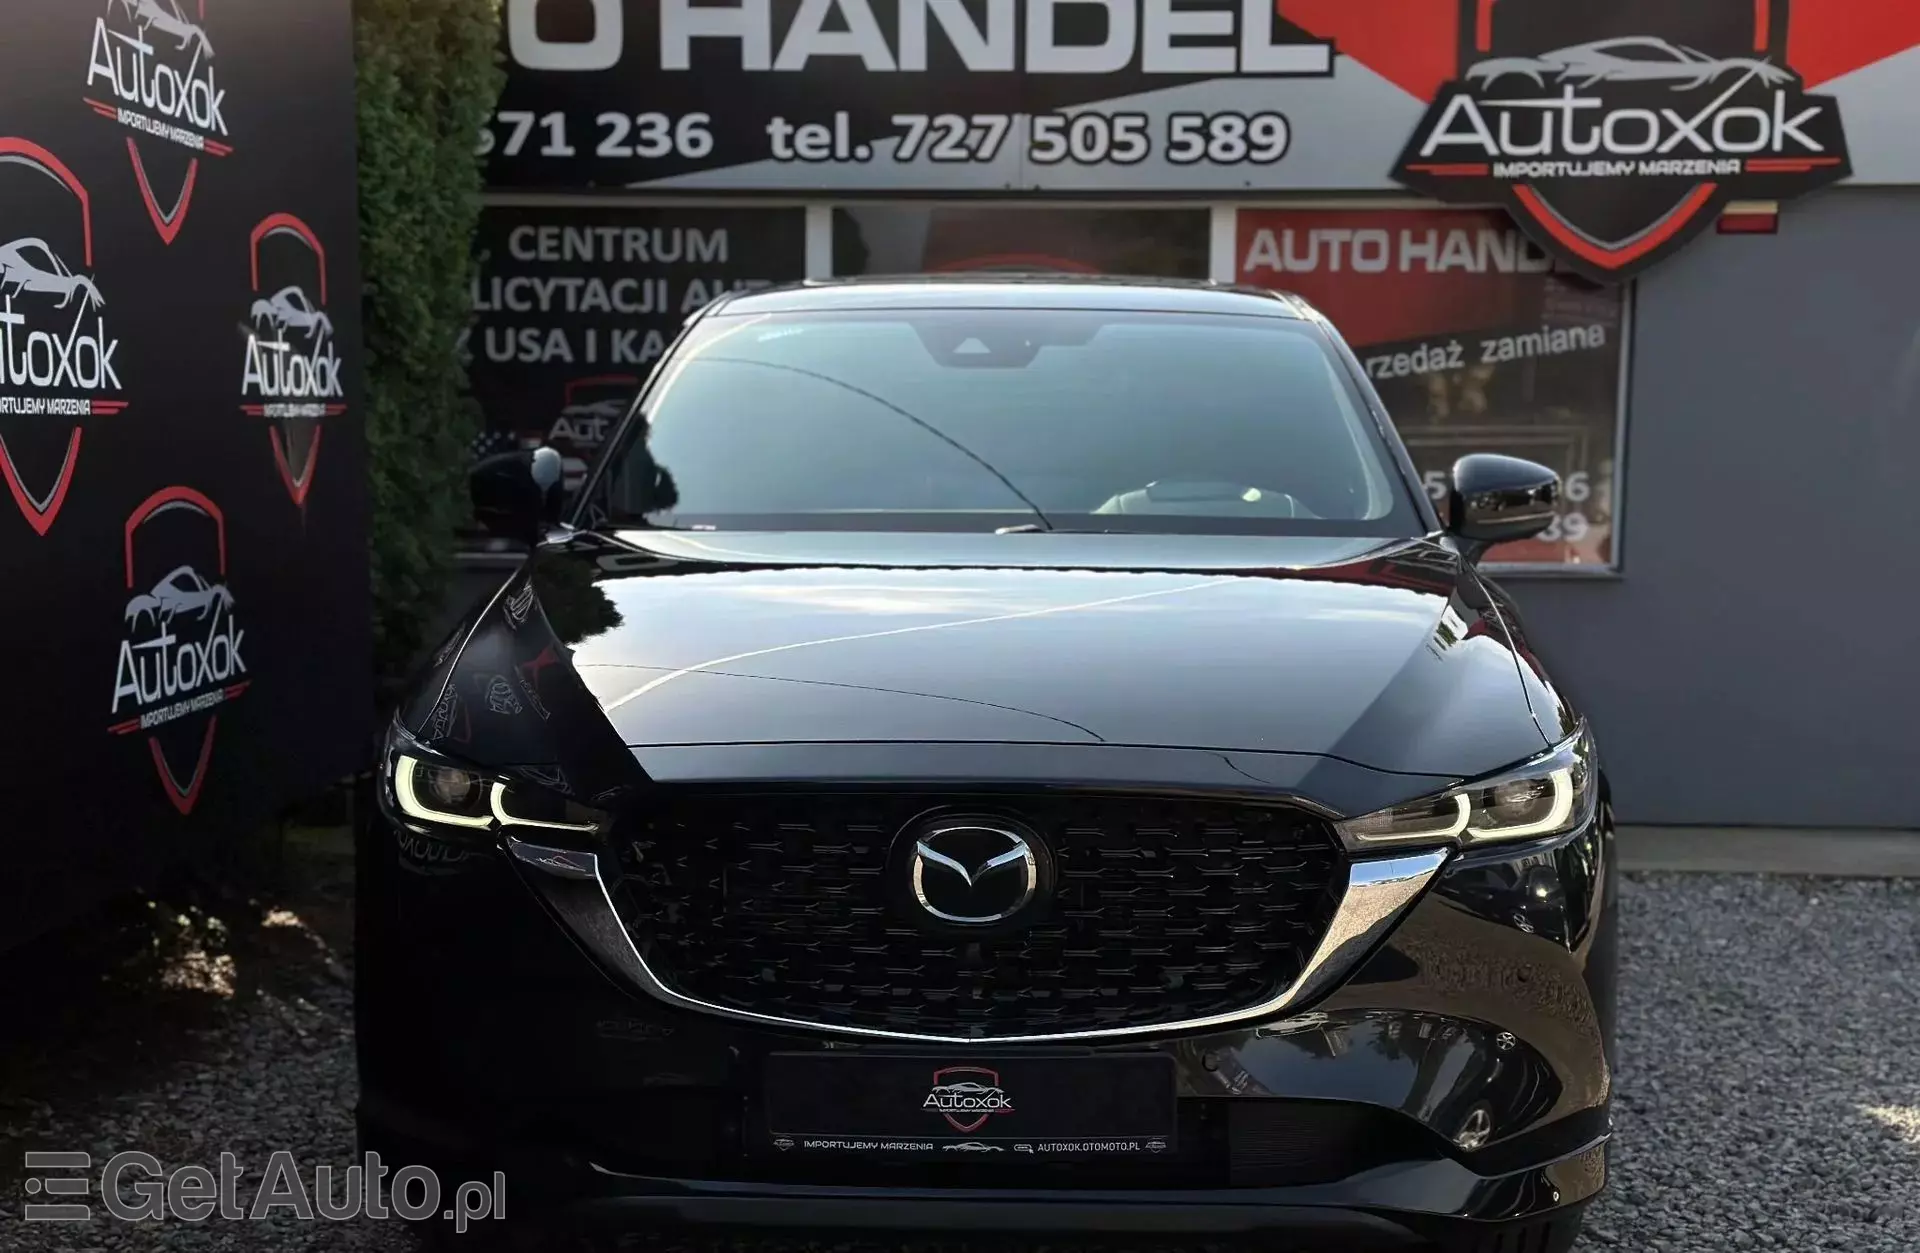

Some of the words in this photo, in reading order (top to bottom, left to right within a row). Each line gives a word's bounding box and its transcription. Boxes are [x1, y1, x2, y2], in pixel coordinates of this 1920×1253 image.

[660, 0, 1330, 74] HANDEL
[87, 17, 228, 136] Autoxok
[1420, 62, 1824, 157] Autoxok
[595, 112, 714, 158] 236
[766, 111, 872, 159] tel.
[892, 113, 1009, 162] 727
[1029, 114, 1149, 162] 505
[1168, 114, 1289, 162] 589
[1493, 161, 1635, 178] IMPORTUJEMY
[1638, 159, 1740, 176] MARZENIA
[509, 226, 728, 263] CENTRUM
[1244, 228, 1389, 273] AUTO
[1399, 227, 1555, 273] HAND
[241, 327, 343, 397] Autoxok
[485, 327, 572, 363] USA
[586, 331, 596, 361] I
[611, 330, 665, 363] KA
[1365, 339, 1464, 379] rzedaż
[1480, 322, 1606, 364] zamiana
[47, 398, 91, 415] MARZENIA
[111, 605, 247, 713] Autoxok
[922, 1090, 1012, 1108] Autoxok
[803, 1140, 878, 1151] IMPORTUJEMY
[880, 1142, 934, 1151] MARZENIA
[1037, 1142, 1141, 1153] AUTOXOK.OTOMOTO.PL
